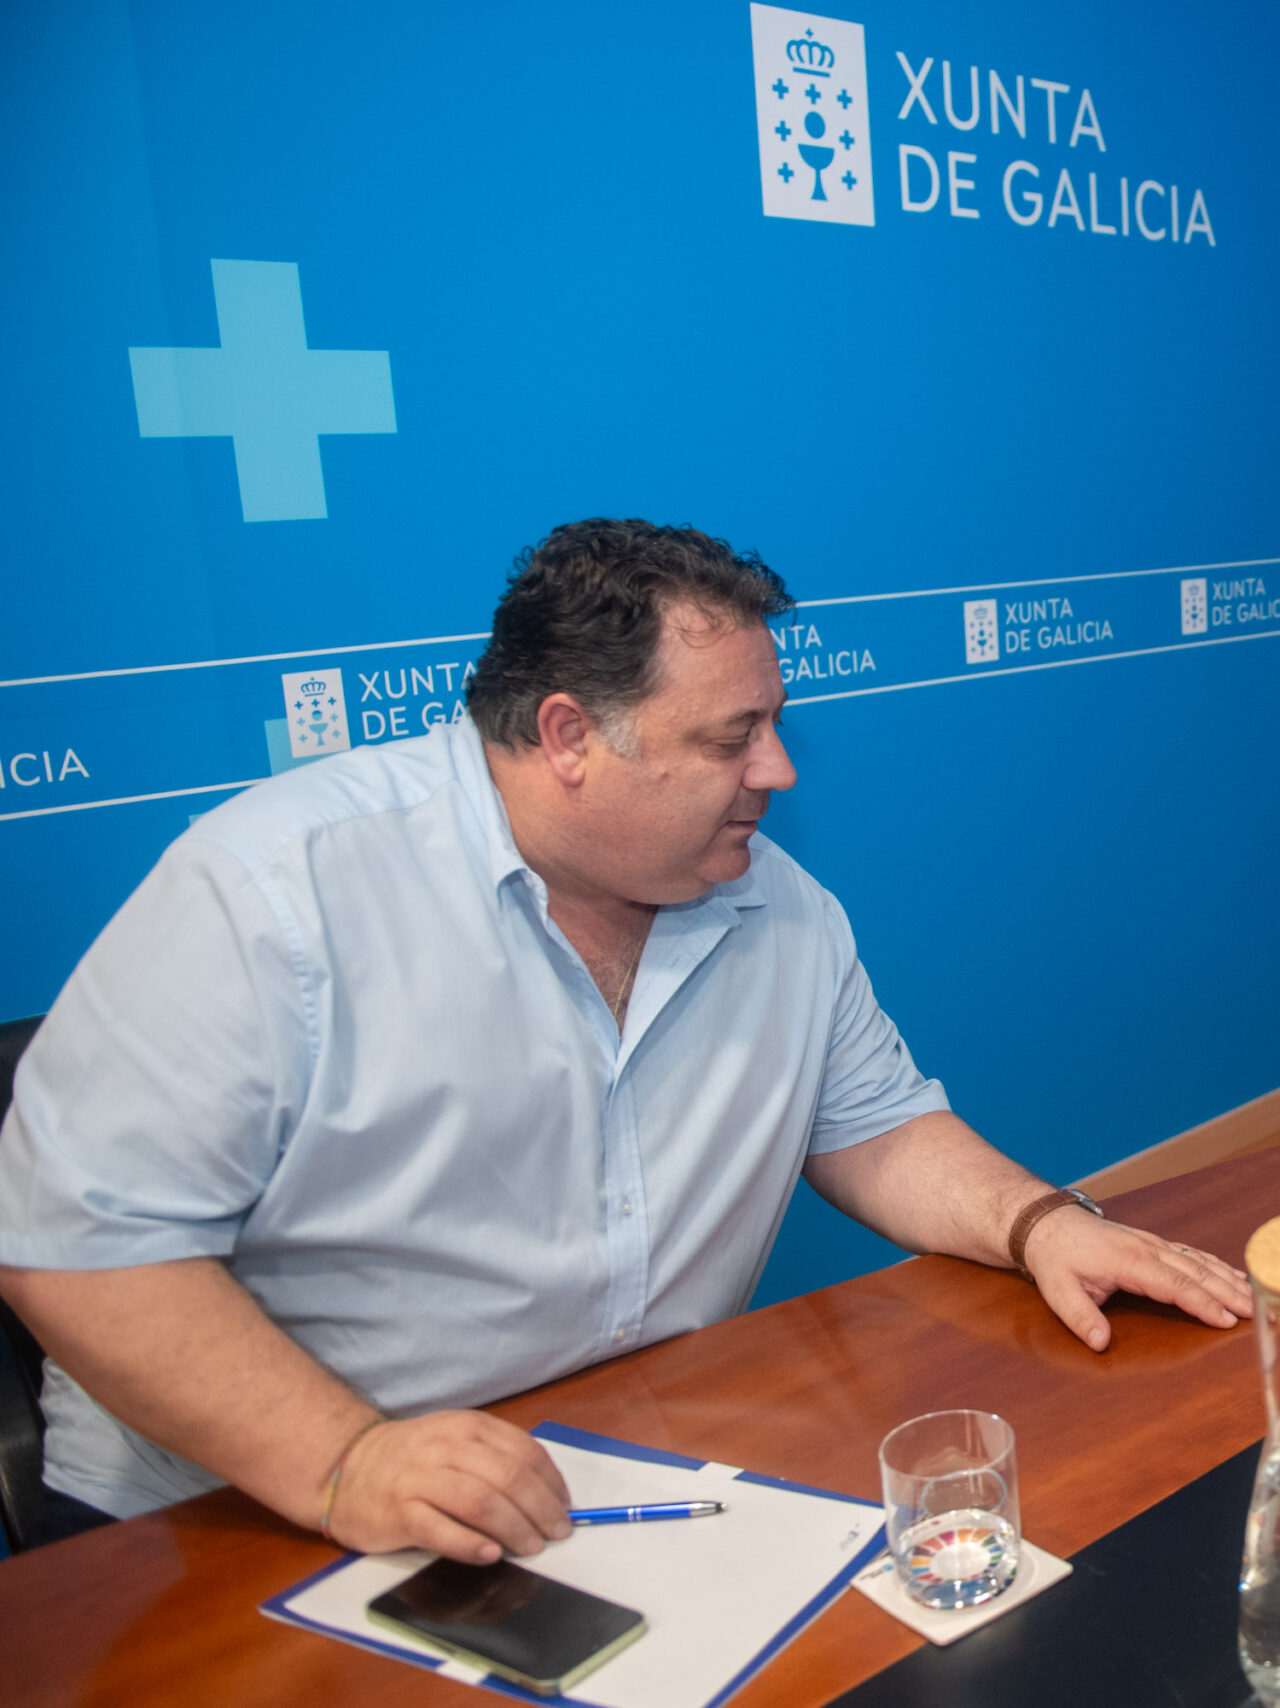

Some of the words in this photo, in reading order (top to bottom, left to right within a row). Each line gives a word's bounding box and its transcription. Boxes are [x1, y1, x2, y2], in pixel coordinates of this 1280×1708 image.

[896, 51, 1106, 152] XUNTA
[899, 144, 980, 219] DE
[1002, 160, 1216, 247] GALICIA
[1213, 578, 1267, 601] XUNTA
[1005, 598, 1074, 625] XUNTA
[1212, 605, 1232, 627] DE
[769, 624, 823, 652] NTA
[1004, 630, 1031, 653] DE
[1037, 620, 1114, 650] GALICIA
[778, 648, 877, 685] GALICIA
[361, 706, 409, 740] DE
